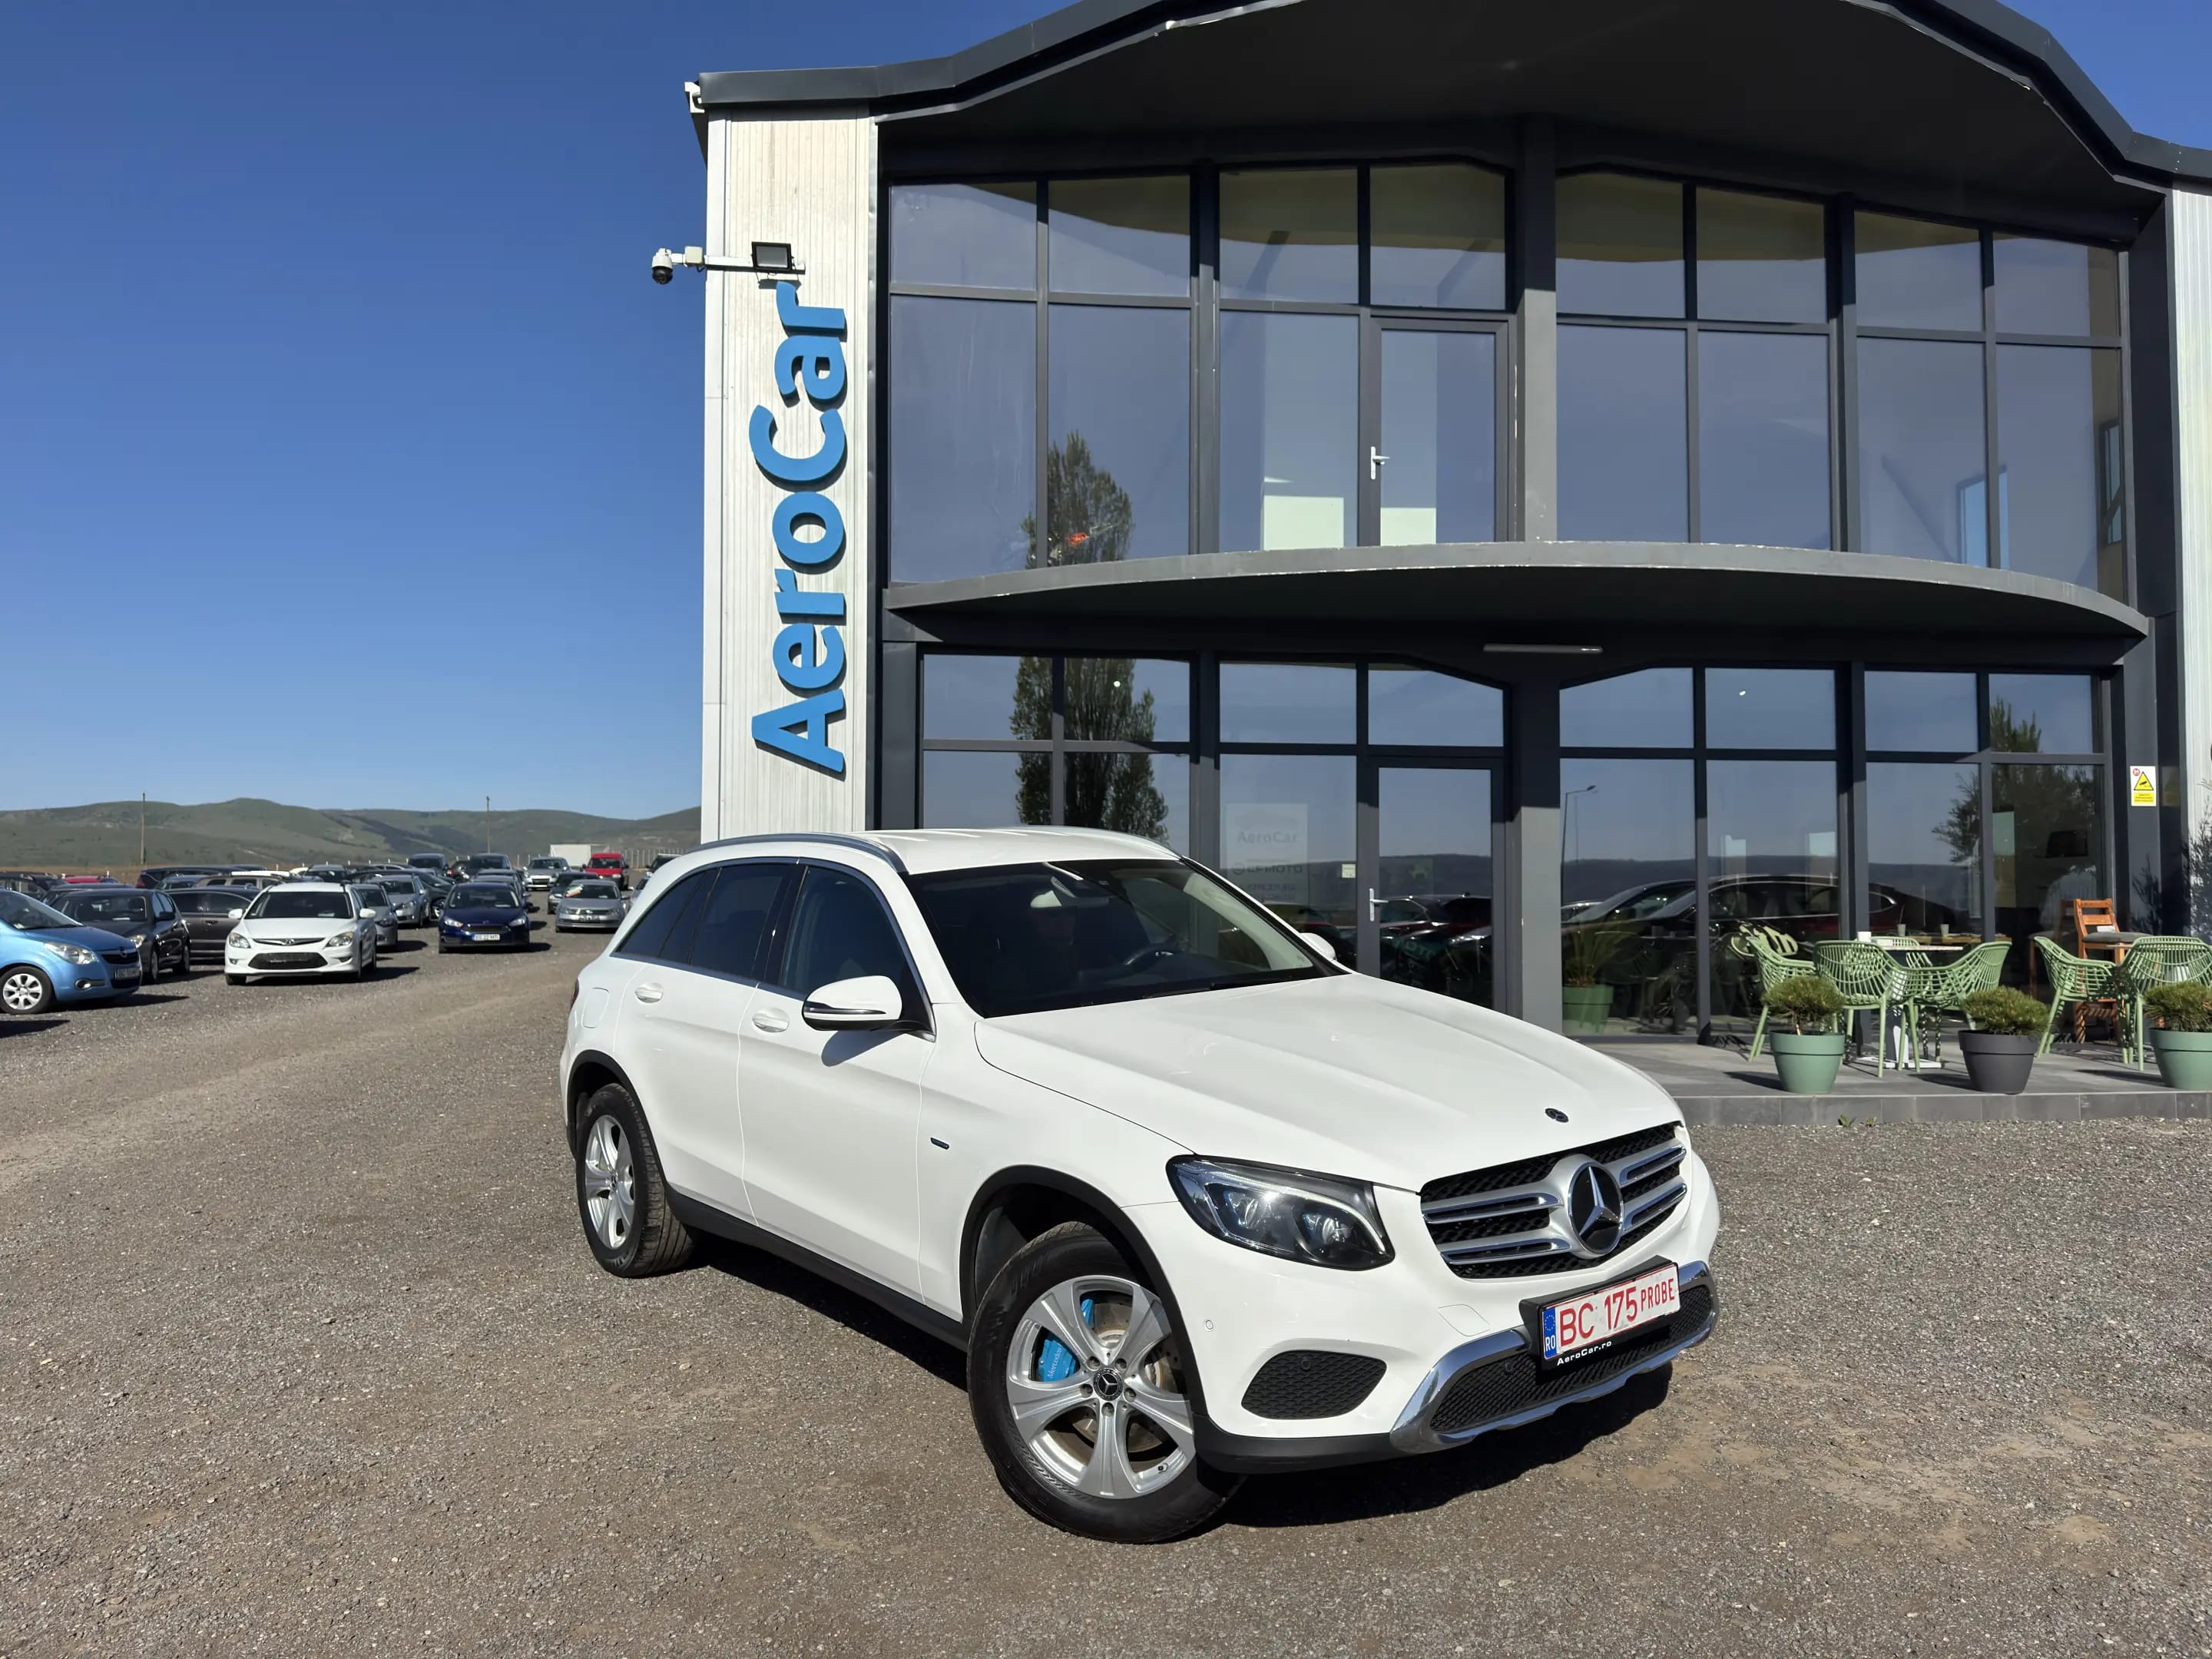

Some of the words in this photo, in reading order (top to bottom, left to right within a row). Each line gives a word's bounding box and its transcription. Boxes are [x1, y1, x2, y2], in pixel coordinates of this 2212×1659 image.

[748, 280, 847, 774] AeroCar
[1559, 1302, 1594, 1346] BC
[1604, 1286, 1637, 1330] 175
[1641, 1278, 1675, 1312] PROBE
[1545, 1335, 1556, 1352] RO
[1556, 1340, 1612, 1366] AeroCar.ro
